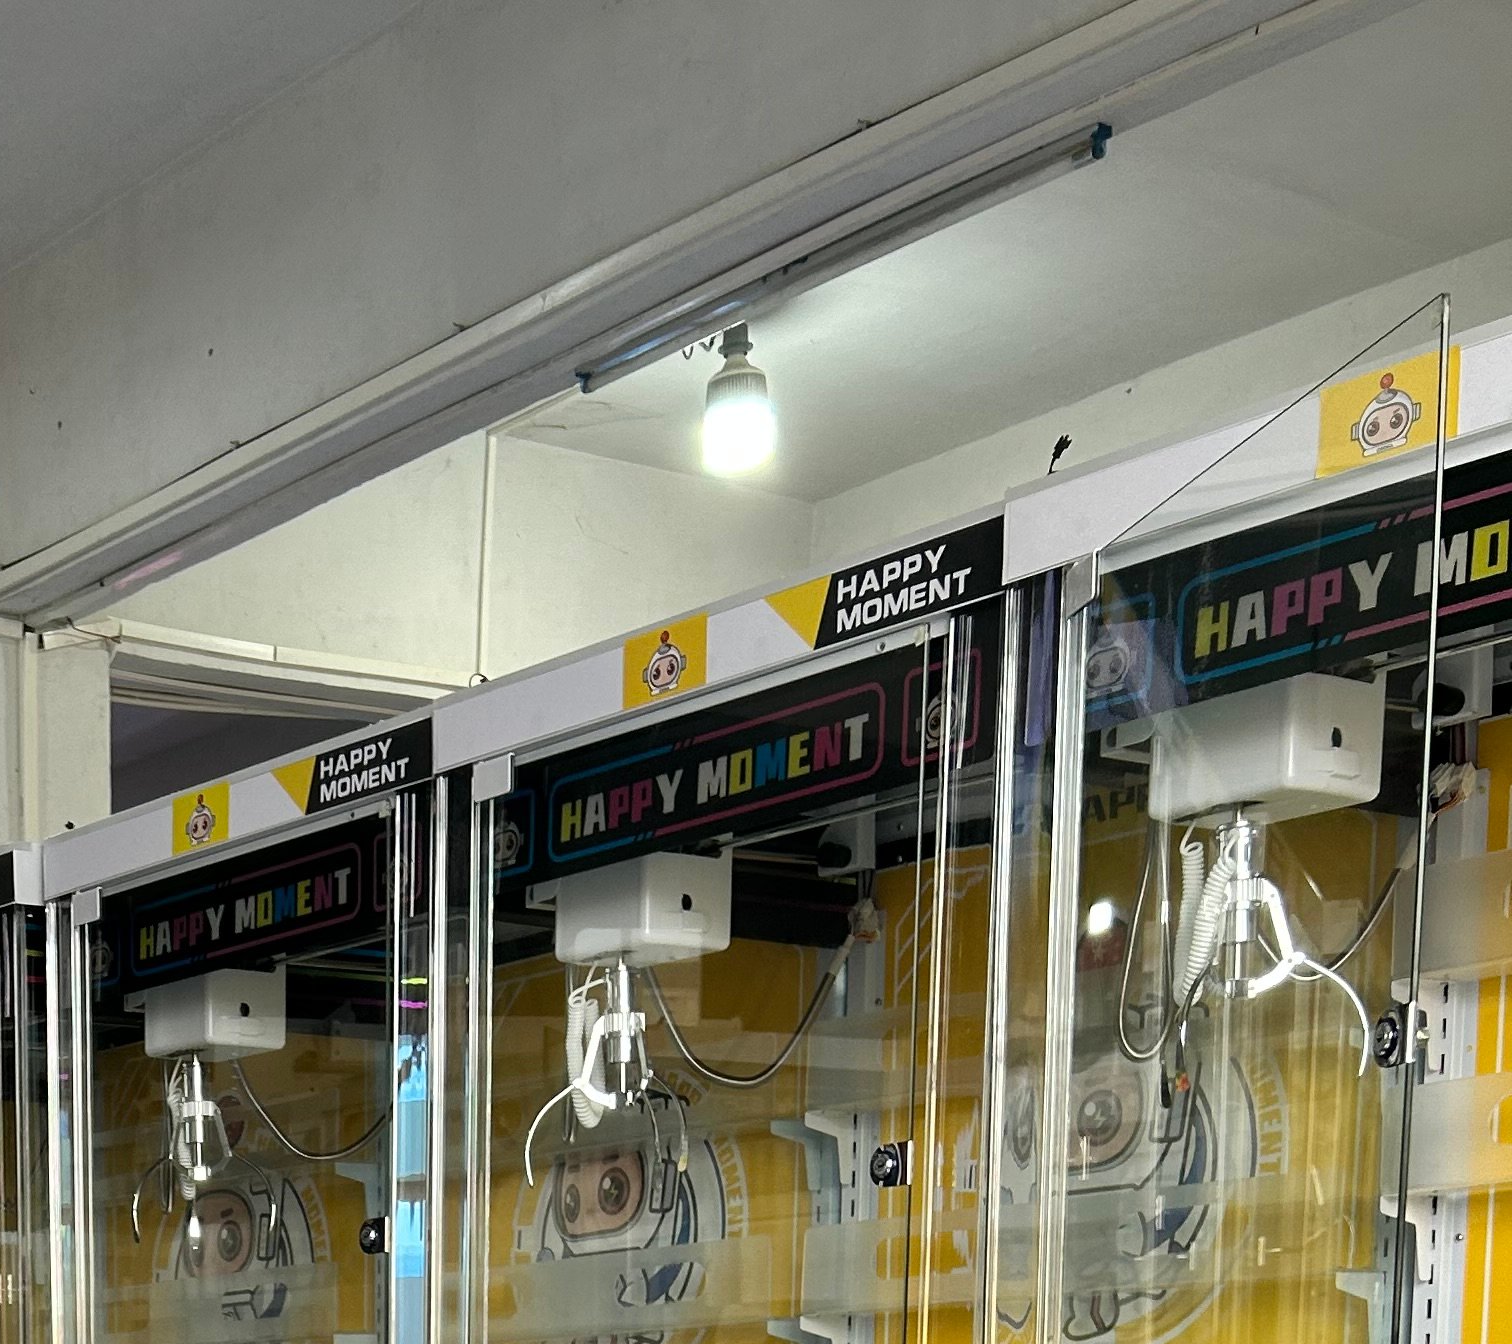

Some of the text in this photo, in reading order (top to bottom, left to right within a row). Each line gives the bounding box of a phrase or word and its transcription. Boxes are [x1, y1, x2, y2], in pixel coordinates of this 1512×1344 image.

[836, 568, 972, 634] MOMENT
[837, 544, 947, 604] HAPPY
[1194, 552, 1392, 658] HAPPY
[319, 738, 393, 779] HAPPY
[319, 756, 410, 803] MOMENT
[561, 713, 870, 844] HAPPY MOMENT
[139, 866, 352, 962] HAPPY MOMENT
